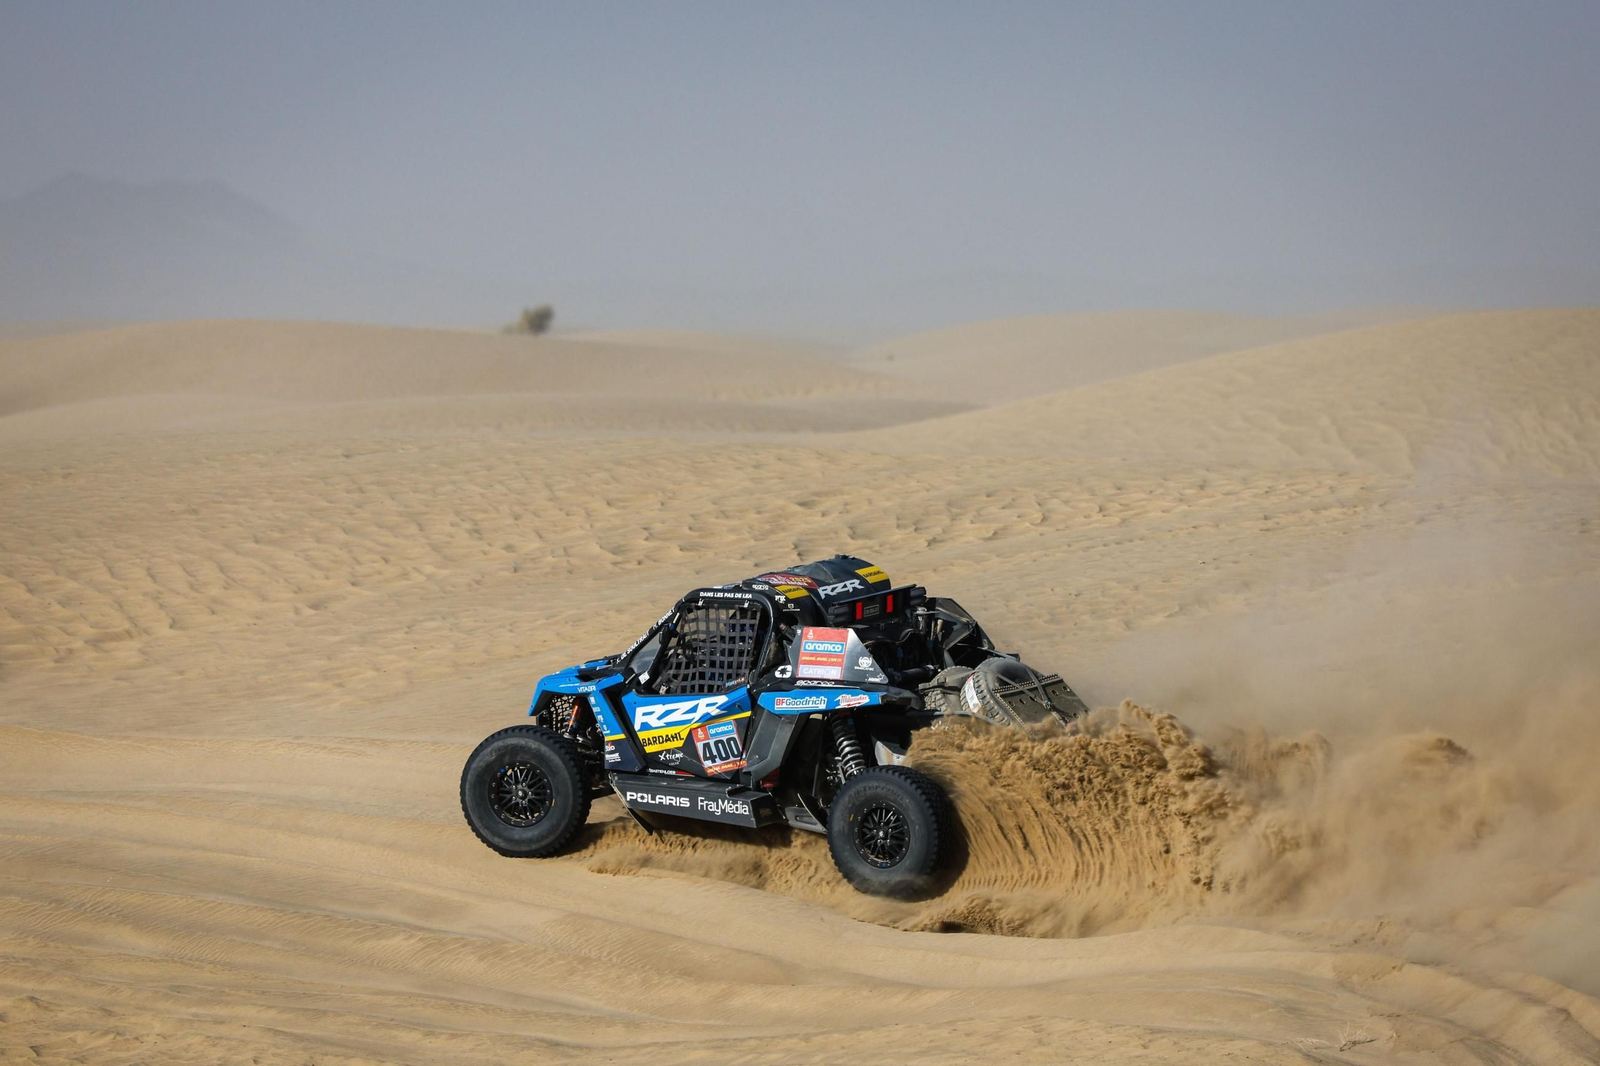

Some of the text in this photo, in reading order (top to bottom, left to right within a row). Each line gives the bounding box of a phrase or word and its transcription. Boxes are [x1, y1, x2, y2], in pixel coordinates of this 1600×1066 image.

[817, 579, 865, 600] RZR
[805, 642, 842, 652] aramco
[803, 667, 837, 676] CATRION
[775, 696, 827, 707] BFGoodrich
[634, 695, 729, 732] RZR
[709, 725, 733, 734] aramco
[641, 732, 684, 748] BARDAHL
[702, 736, 742, 764] 400
[626, 791, 691, 808] POLARIS
[698, 796, 750, 815] FrayMédia
